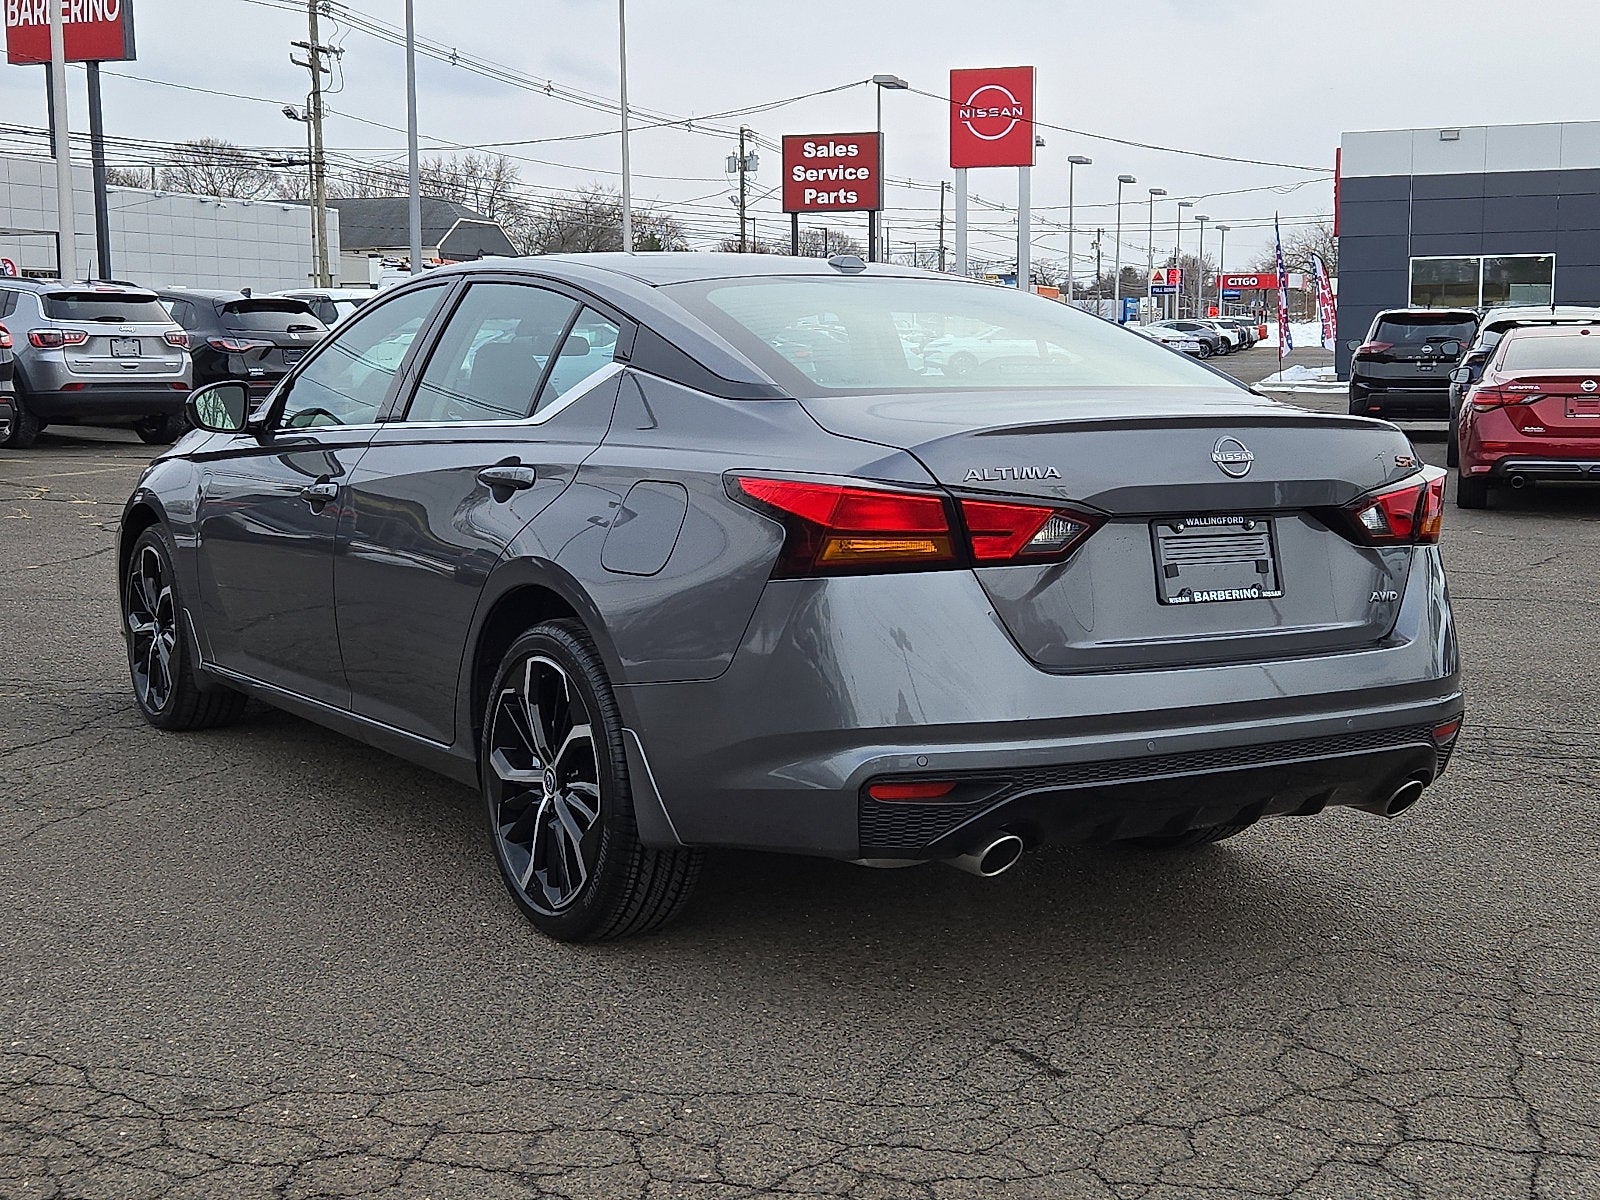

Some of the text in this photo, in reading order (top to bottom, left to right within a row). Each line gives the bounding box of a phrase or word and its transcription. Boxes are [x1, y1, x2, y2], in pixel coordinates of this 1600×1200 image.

[959, 106, 1023, 119] NISSAN
[803, 141, 859, 158] Sales
[792, 164, 870, 182] Service
[804, 187, 858, 205] Parts
[1227, 277, 1258, 286] CITGO
[1212, 451, 1254, 462] NISSAN
[963, 466, 1062, 482] ALTIMA
[1185, 516, 1244, 526] WALLINGFORD
[1193, 588, 1259, 602] BARBERINO
[1369, 590, 1398, 603] AWD
